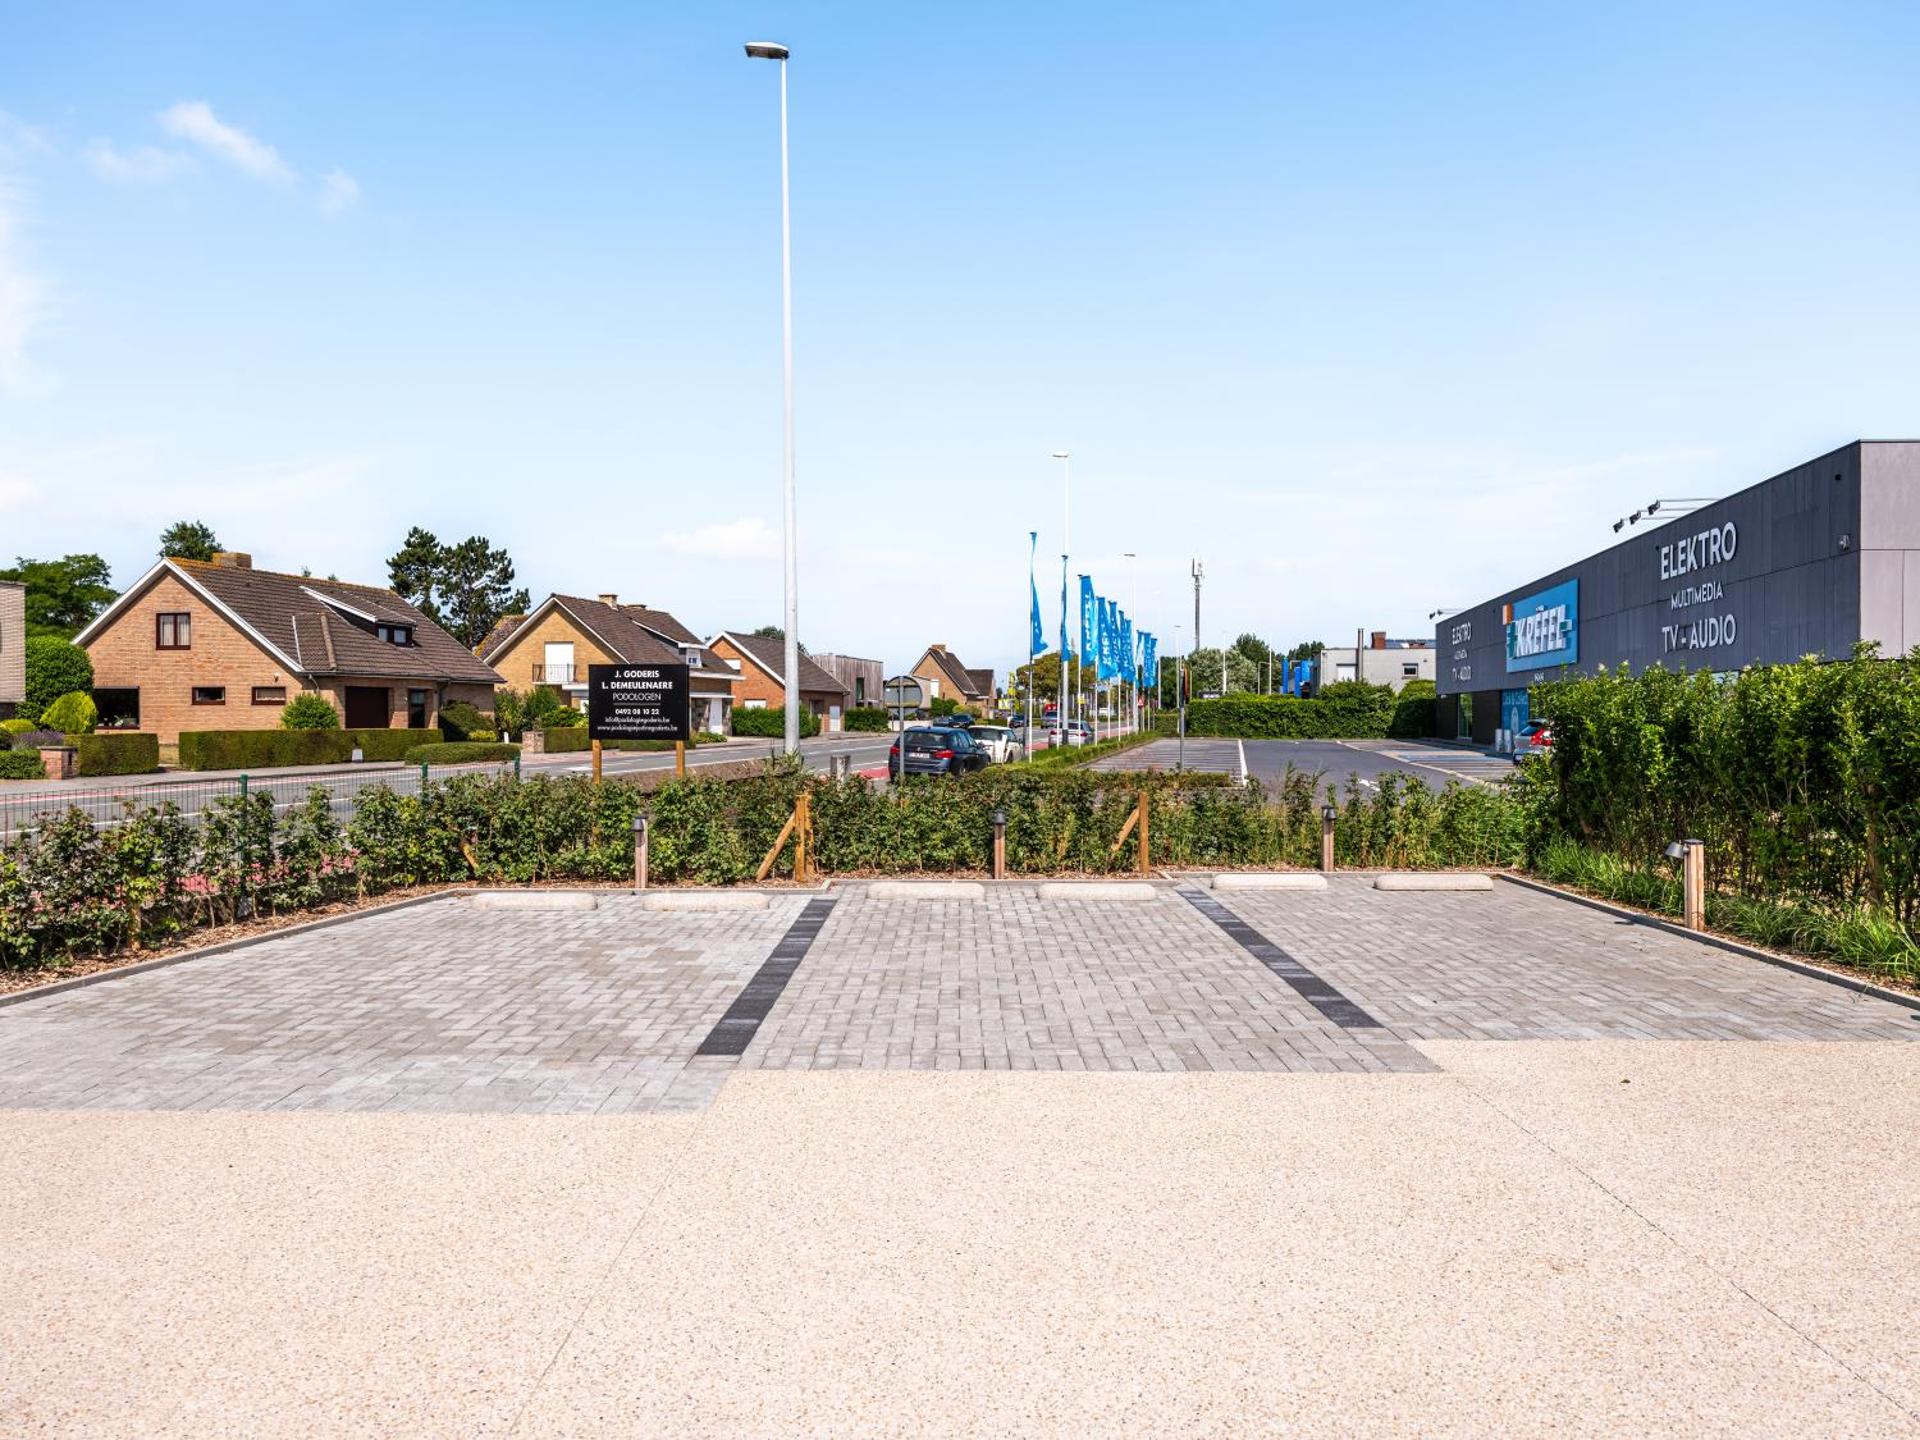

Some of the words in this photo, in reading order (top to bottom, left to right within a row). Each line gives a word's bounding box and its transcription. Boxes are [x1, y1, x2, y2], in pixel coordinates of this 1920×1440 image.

[1660, 521, 1737, 581] ELEKTRO
[1671, 580, 1724, 610] MULTIMEDIA
[1452, 621, 1472, 646] ELEKTRO
[1662, 624, 1679, 654] TV
[1689, 614, 1737, 650] AUDIO
[611, 681, 673, 689] DEMEULENAERE
[615, 670, 622, 678] J.
[623, 670, 660, 678] GODERIS
[612, 692, 661, 701] PODOLOGEN
